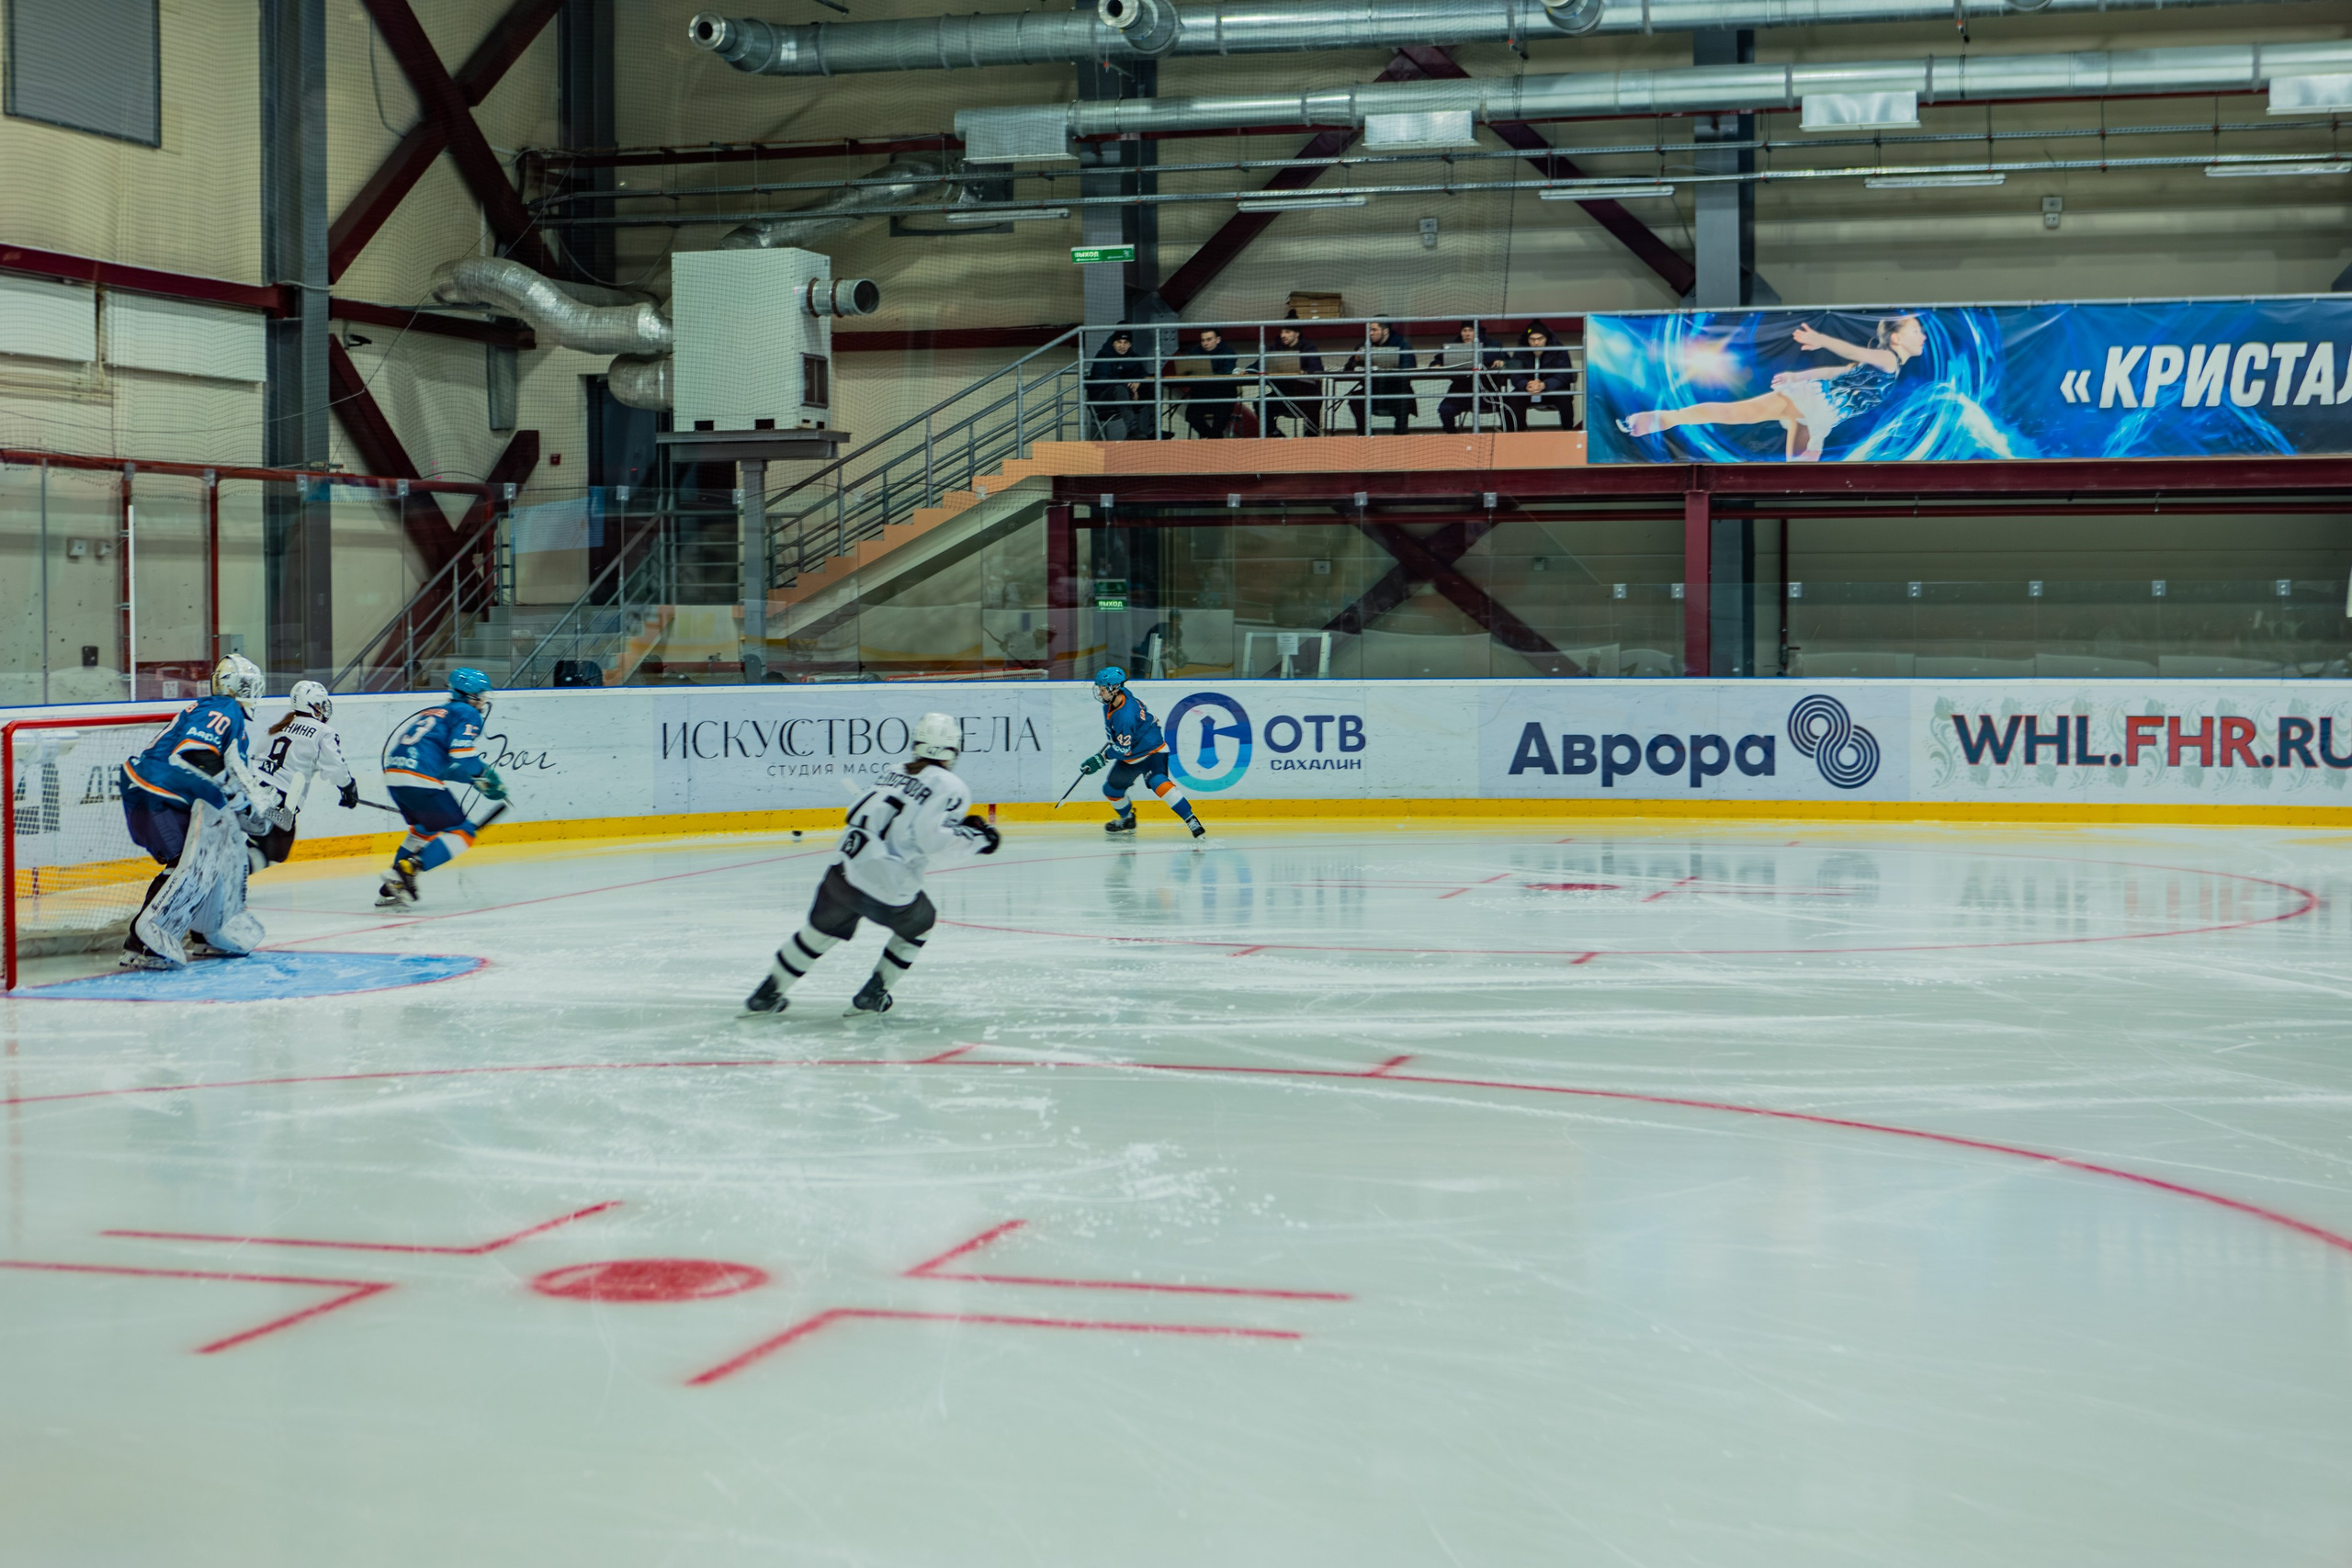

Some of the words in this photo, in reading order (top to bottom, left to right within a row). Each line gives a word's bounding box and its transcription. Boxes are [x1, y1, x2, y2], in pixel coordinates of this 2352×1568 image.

[2059, 341, 2352, 410] «КРИСТА
[206, 710, 232, 736] 70
[280, 722, 317, 739] НИНА
[662, 716, 910, 761] ИСКУССТВО
[956, 715, 1043, 754] ЕЛА
[1263, 715, 1366, 754] ОТВ
[267, 736, 292, 768] 9
[1116, 733, 1132, 747] 42
[1507, 721, 1776, 788] Аврора
[1951, 714, 2352, 770] WHL.FHR.RU
[766, 763, 834, 777] СТУДИЯ
[842, 762, 891, 775] МАСС
[1270, 759, 1362, 771] САХАЛИН
